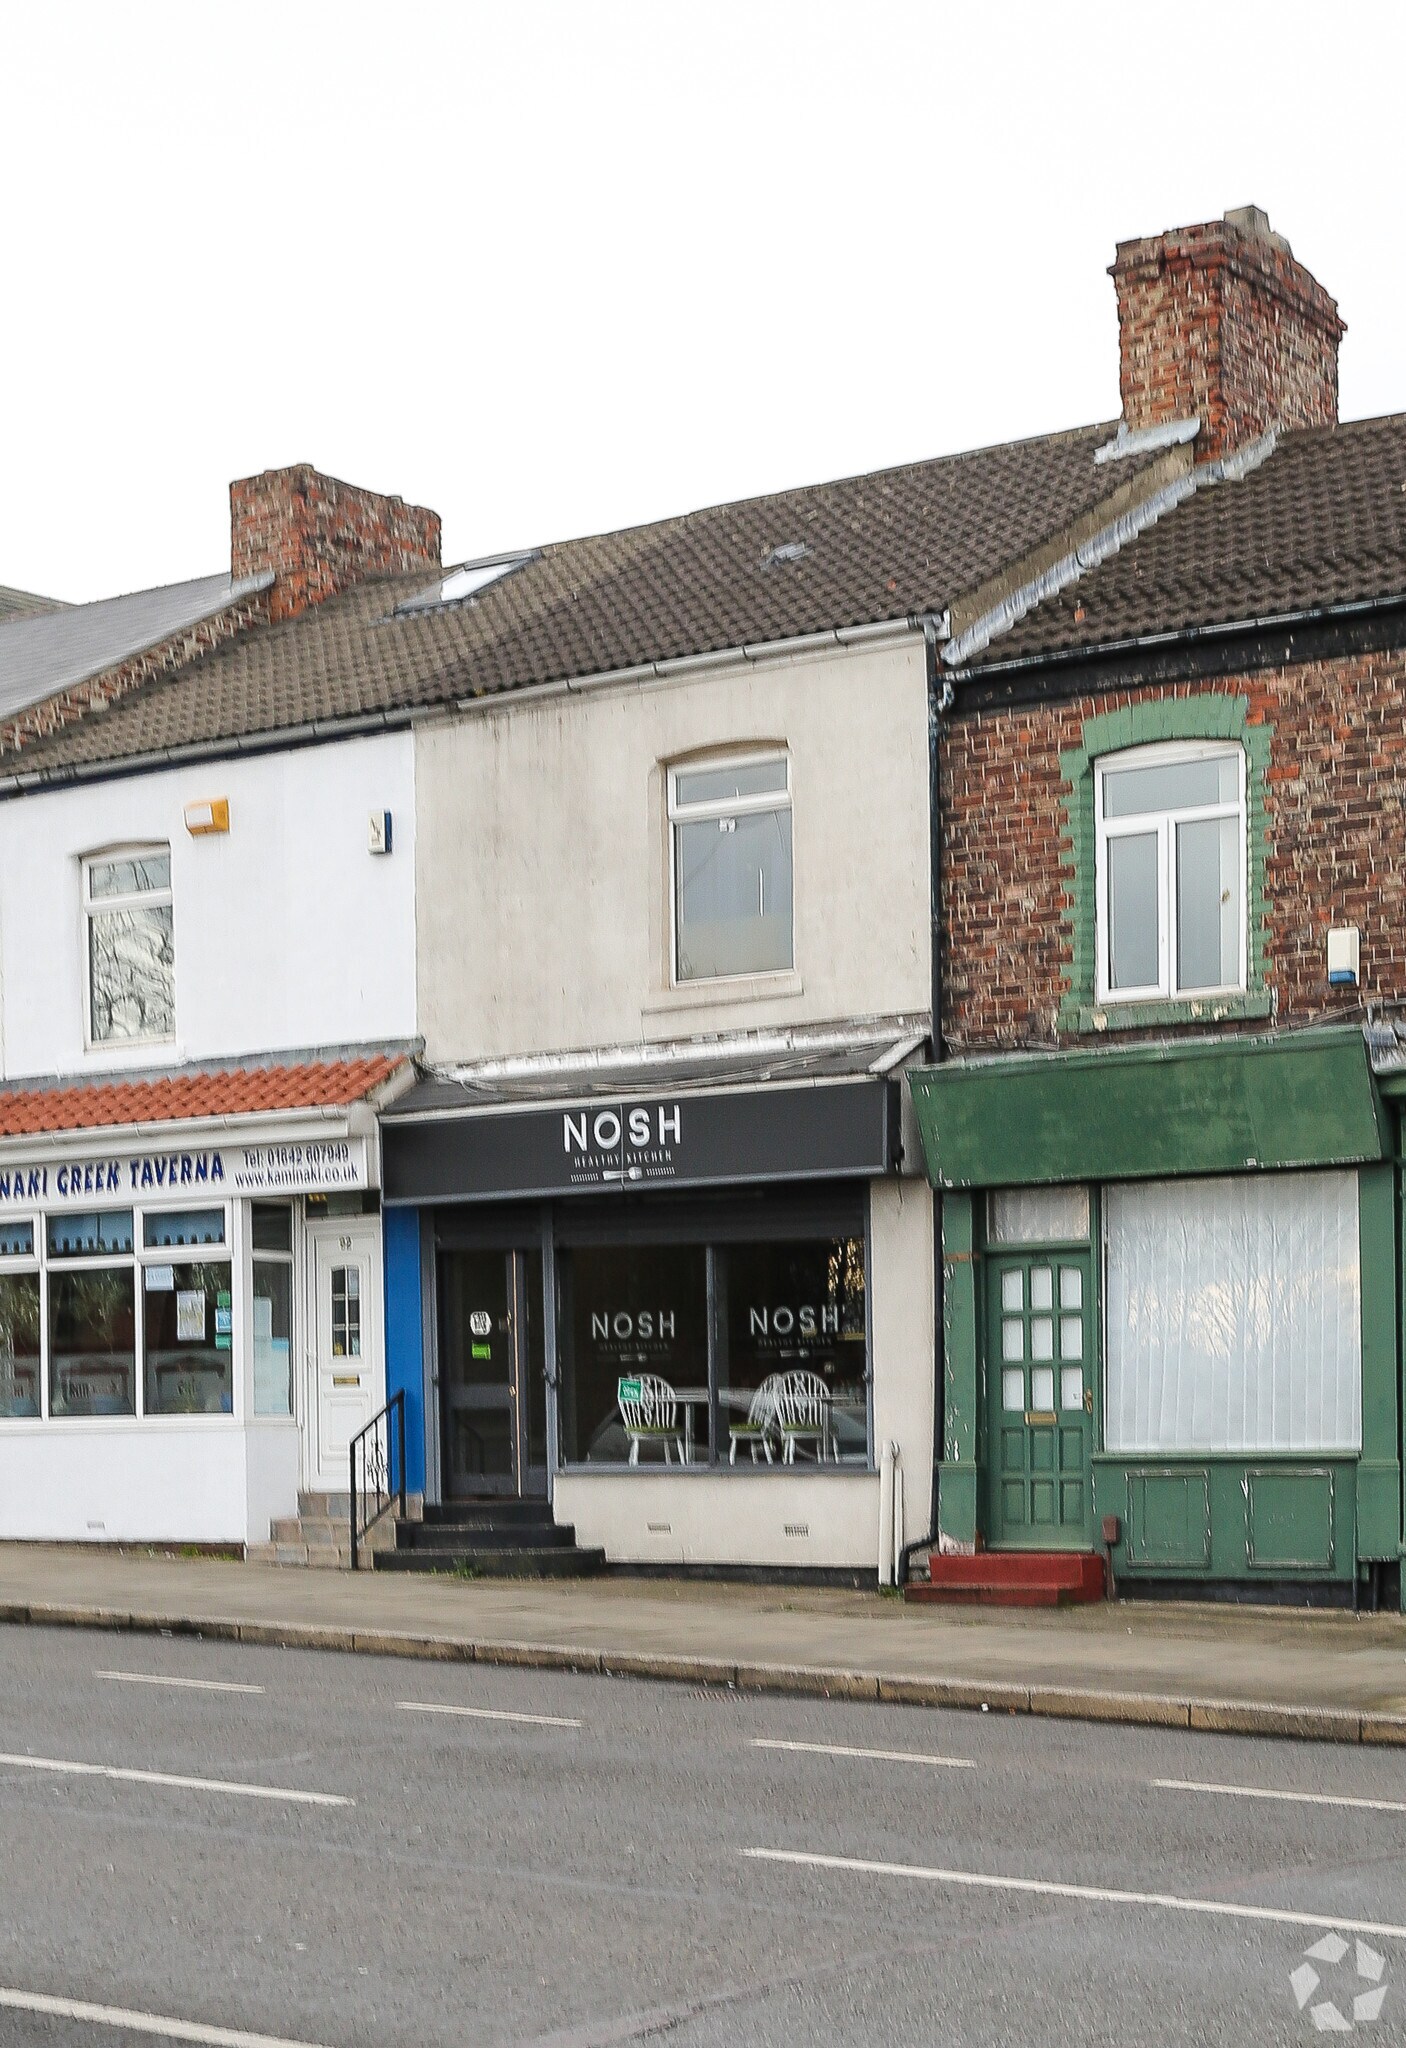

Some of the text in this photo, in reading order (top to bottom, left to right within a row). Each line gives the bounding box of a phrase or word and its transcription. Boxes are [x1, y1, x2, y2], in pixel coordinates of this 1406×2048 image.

[563, 1104, 681, 1153] NOSH
[242, 1149, 264, 1169] Tel:
[574, 1149, 673, 1168] HEALTHY KITCHEN
[56, 1159, 120, 1197] GREEK
[129, 1152, 225, 1189] TAVERNA
[235, 1162, 359, 1189] www.kaminaki.co.uk
[591, 1310, 675, 1340] NOSH
[749, 1304, 839, 1336] NOSH
